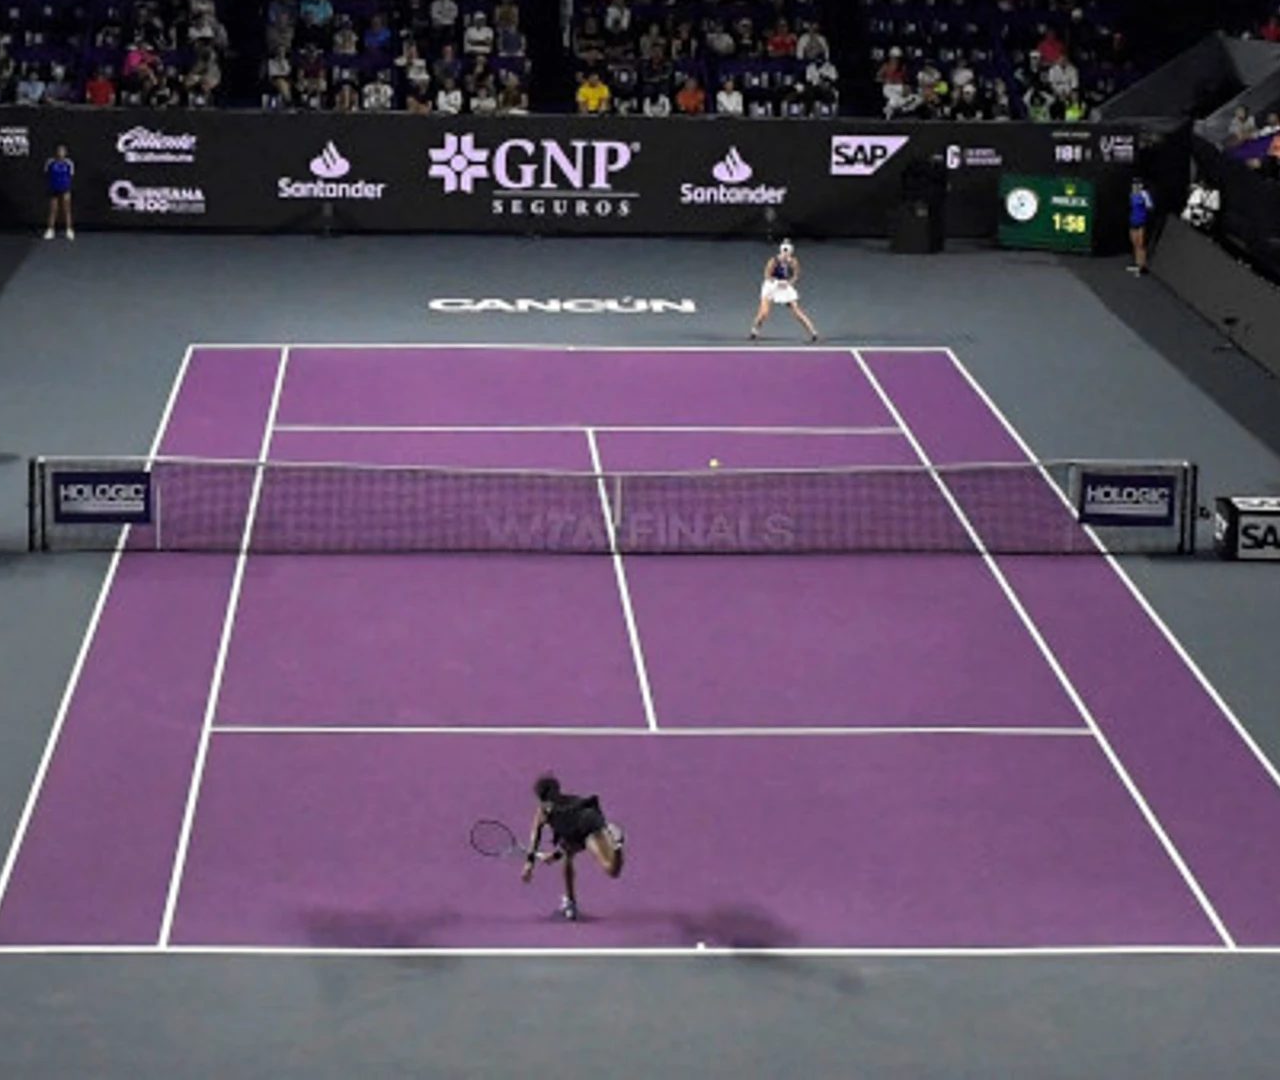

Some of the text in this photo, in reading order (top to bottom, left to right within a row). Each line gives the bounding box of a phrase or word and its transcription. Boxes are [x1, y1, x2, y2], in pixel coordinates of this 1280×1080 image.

[493, 138, 632, 191] GNP
[834, 144, 888, 166] SAP
[278, 178, 385, 199] Santander
[681, 183, 787, 204] Santander
[492, 199, 631, 216] SEGUROS
[60, 484, 147, 501] HOLOGIC
[1086, 484, 1170, 504] HOLOGIC
